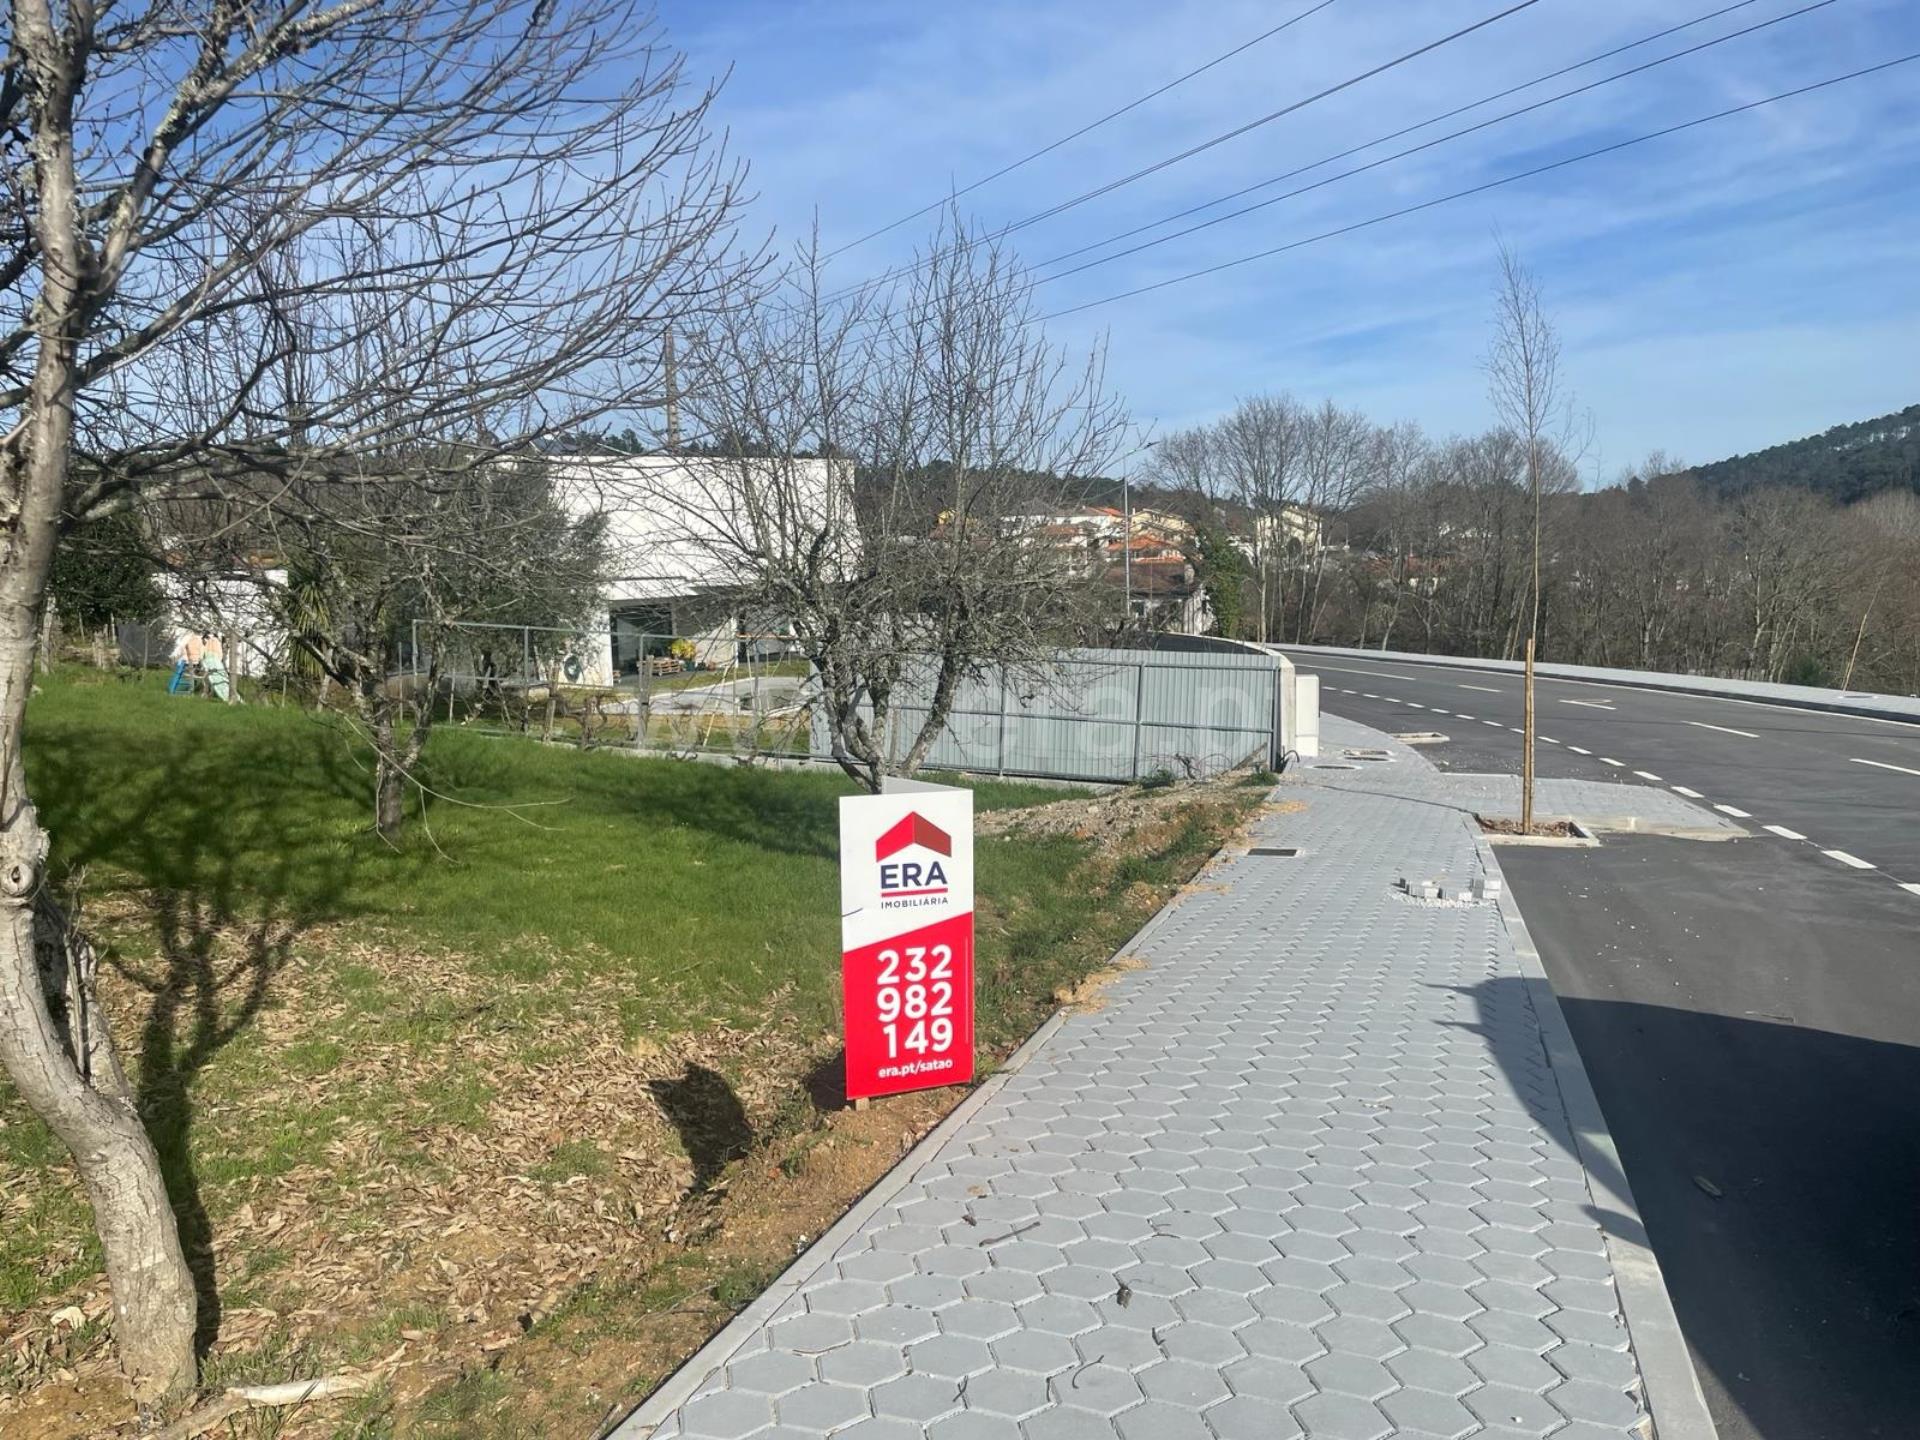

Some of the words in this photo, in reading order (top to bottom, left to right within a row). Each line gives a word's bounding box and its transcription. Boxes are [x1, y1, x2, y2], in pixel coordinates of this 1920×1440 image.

[881, 861, 948, 889] ERA
[881, 897, 948, 909] IMOBILIÁRIA
[877, 944, 953, 985] 232
[877, 981, 953, 1022] 982
[883, 1018, 953, 1058] 149
[878, 1058, 953, 1078] era.pt/satao
